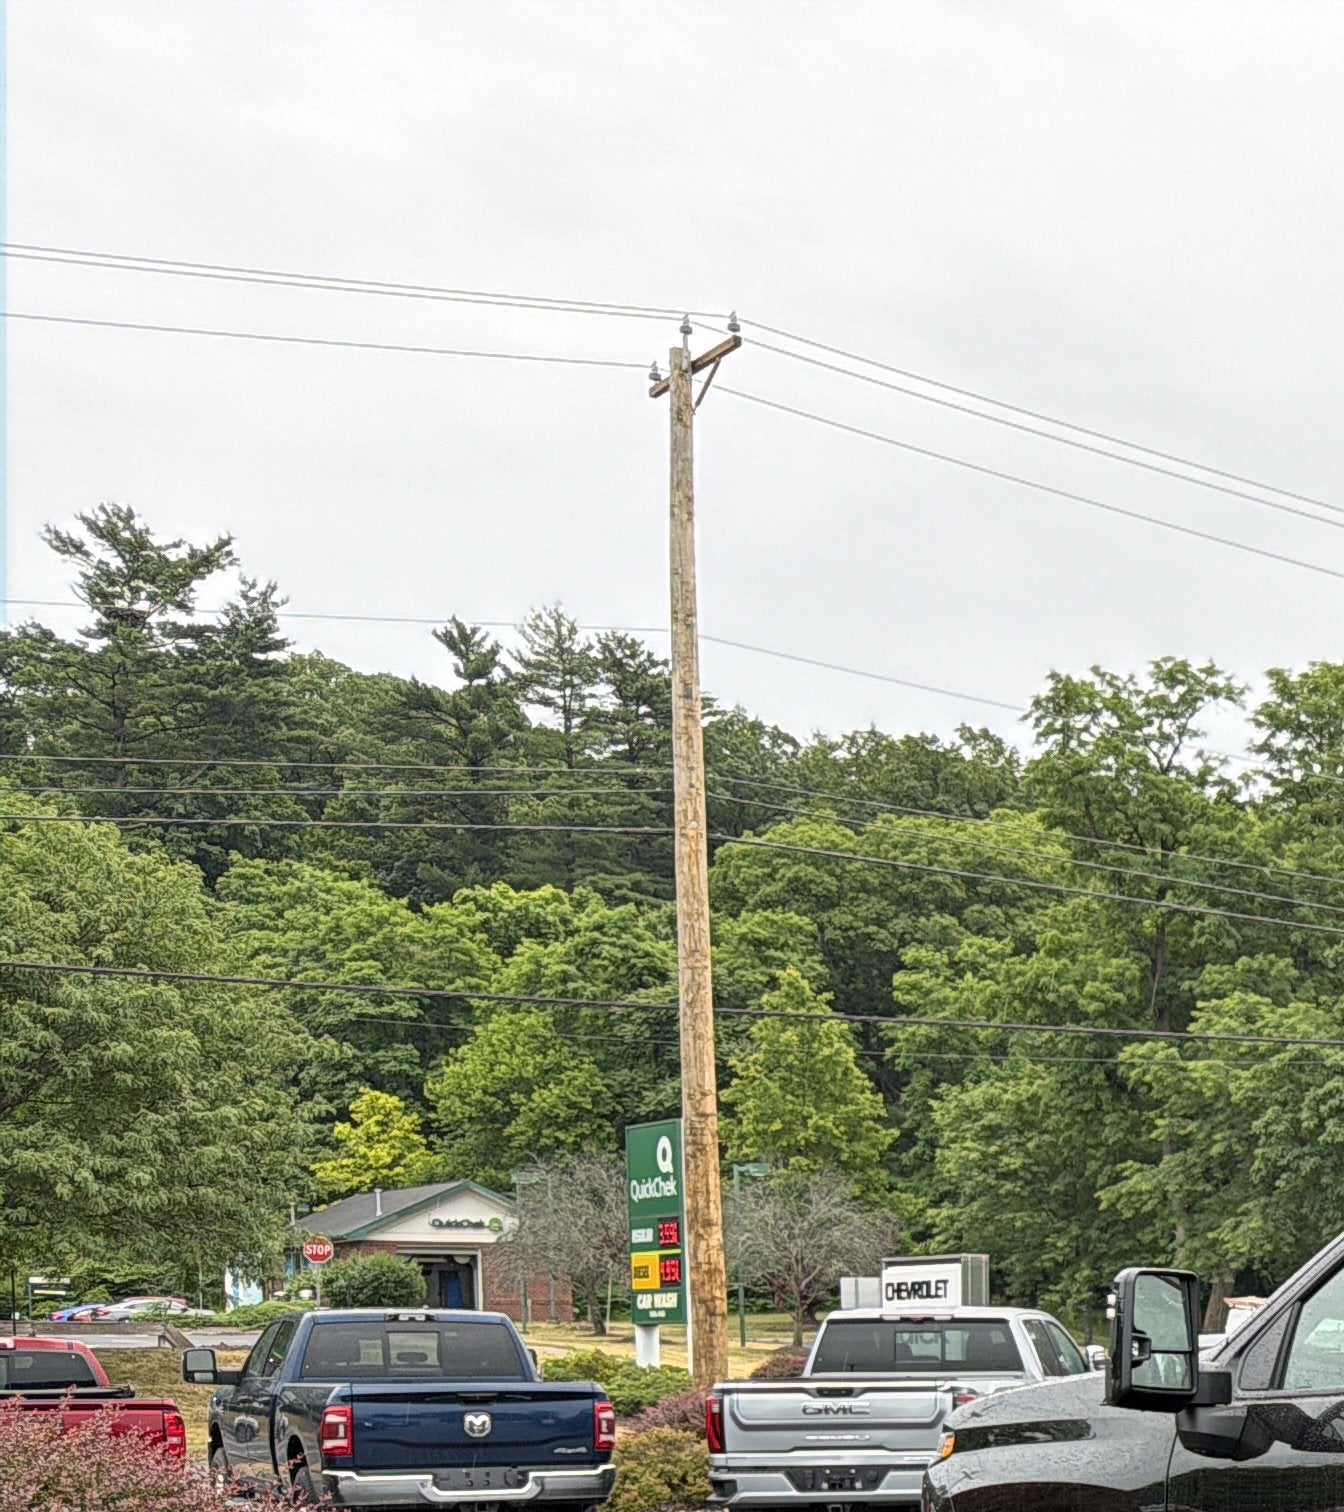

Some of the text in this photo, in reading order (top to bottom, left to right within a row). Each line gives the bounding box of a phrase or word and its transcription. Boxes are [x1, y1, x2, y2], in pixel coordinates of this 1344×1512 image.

[656, 1135, 674, 1173] Q
[630, 1175, 678, 1203] QuickChek
[305, 1244, 332, 1256] STOP
[885, 1279, 949, 1301] CHEVROLET
[802, 1401, 870, 1415] GMC
